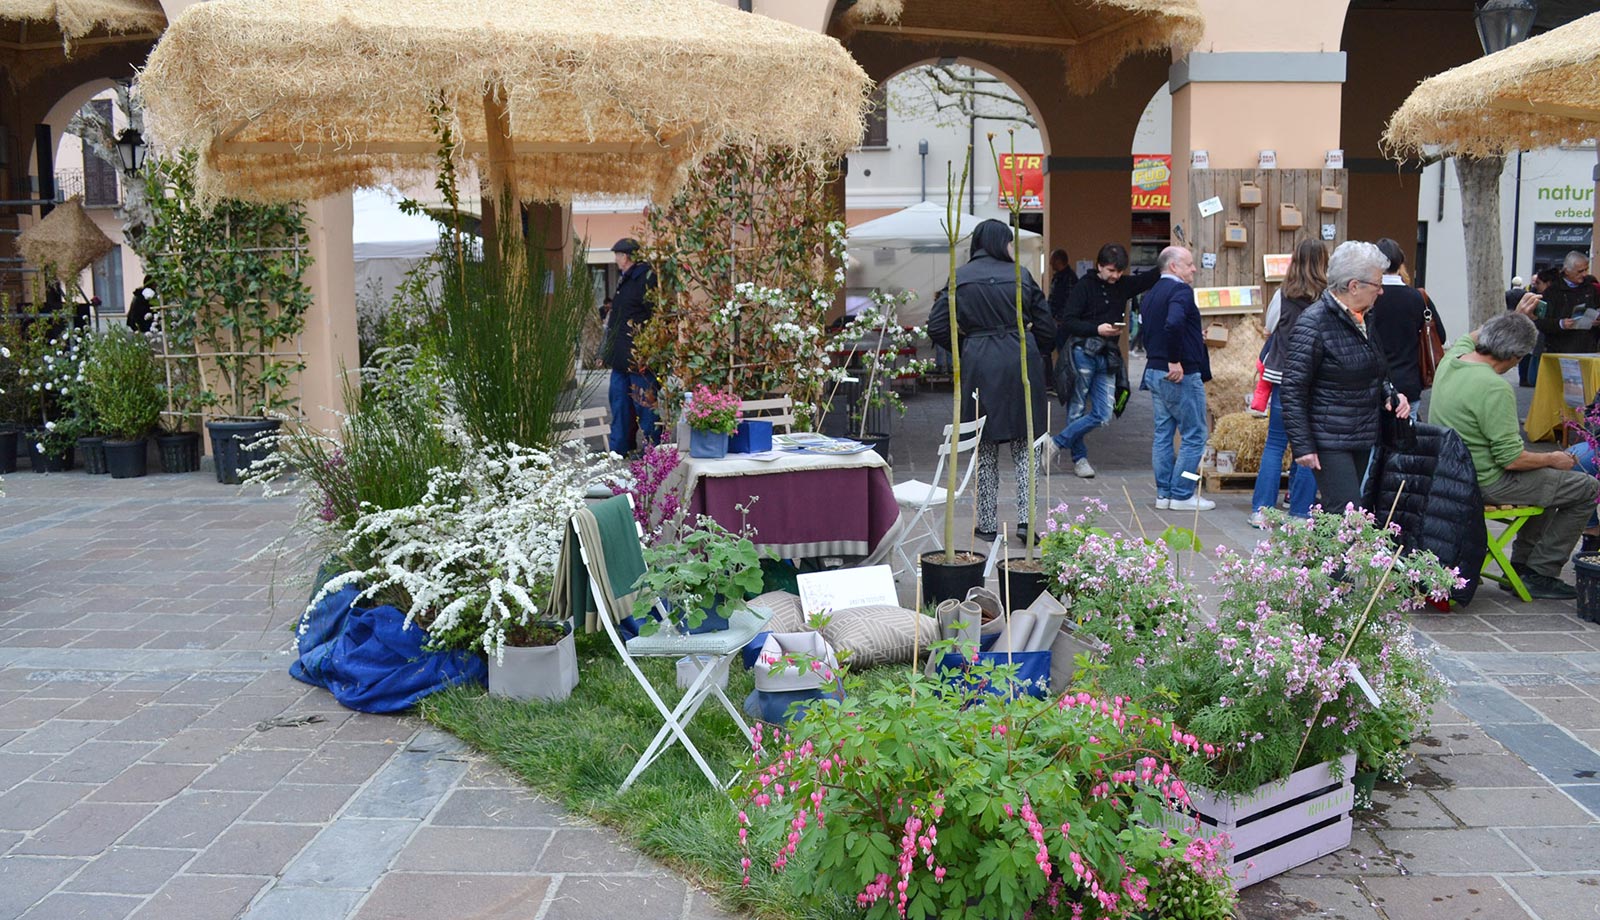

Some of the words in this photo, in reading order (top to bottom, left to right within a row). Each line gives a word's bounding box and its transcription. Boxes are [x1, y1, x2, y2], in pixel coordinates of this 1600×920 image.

[1003, 156, 1040, 169] STR
[1538, 184, 1594, 200] natur
[1131, 194, 1171, 206] IVAL
